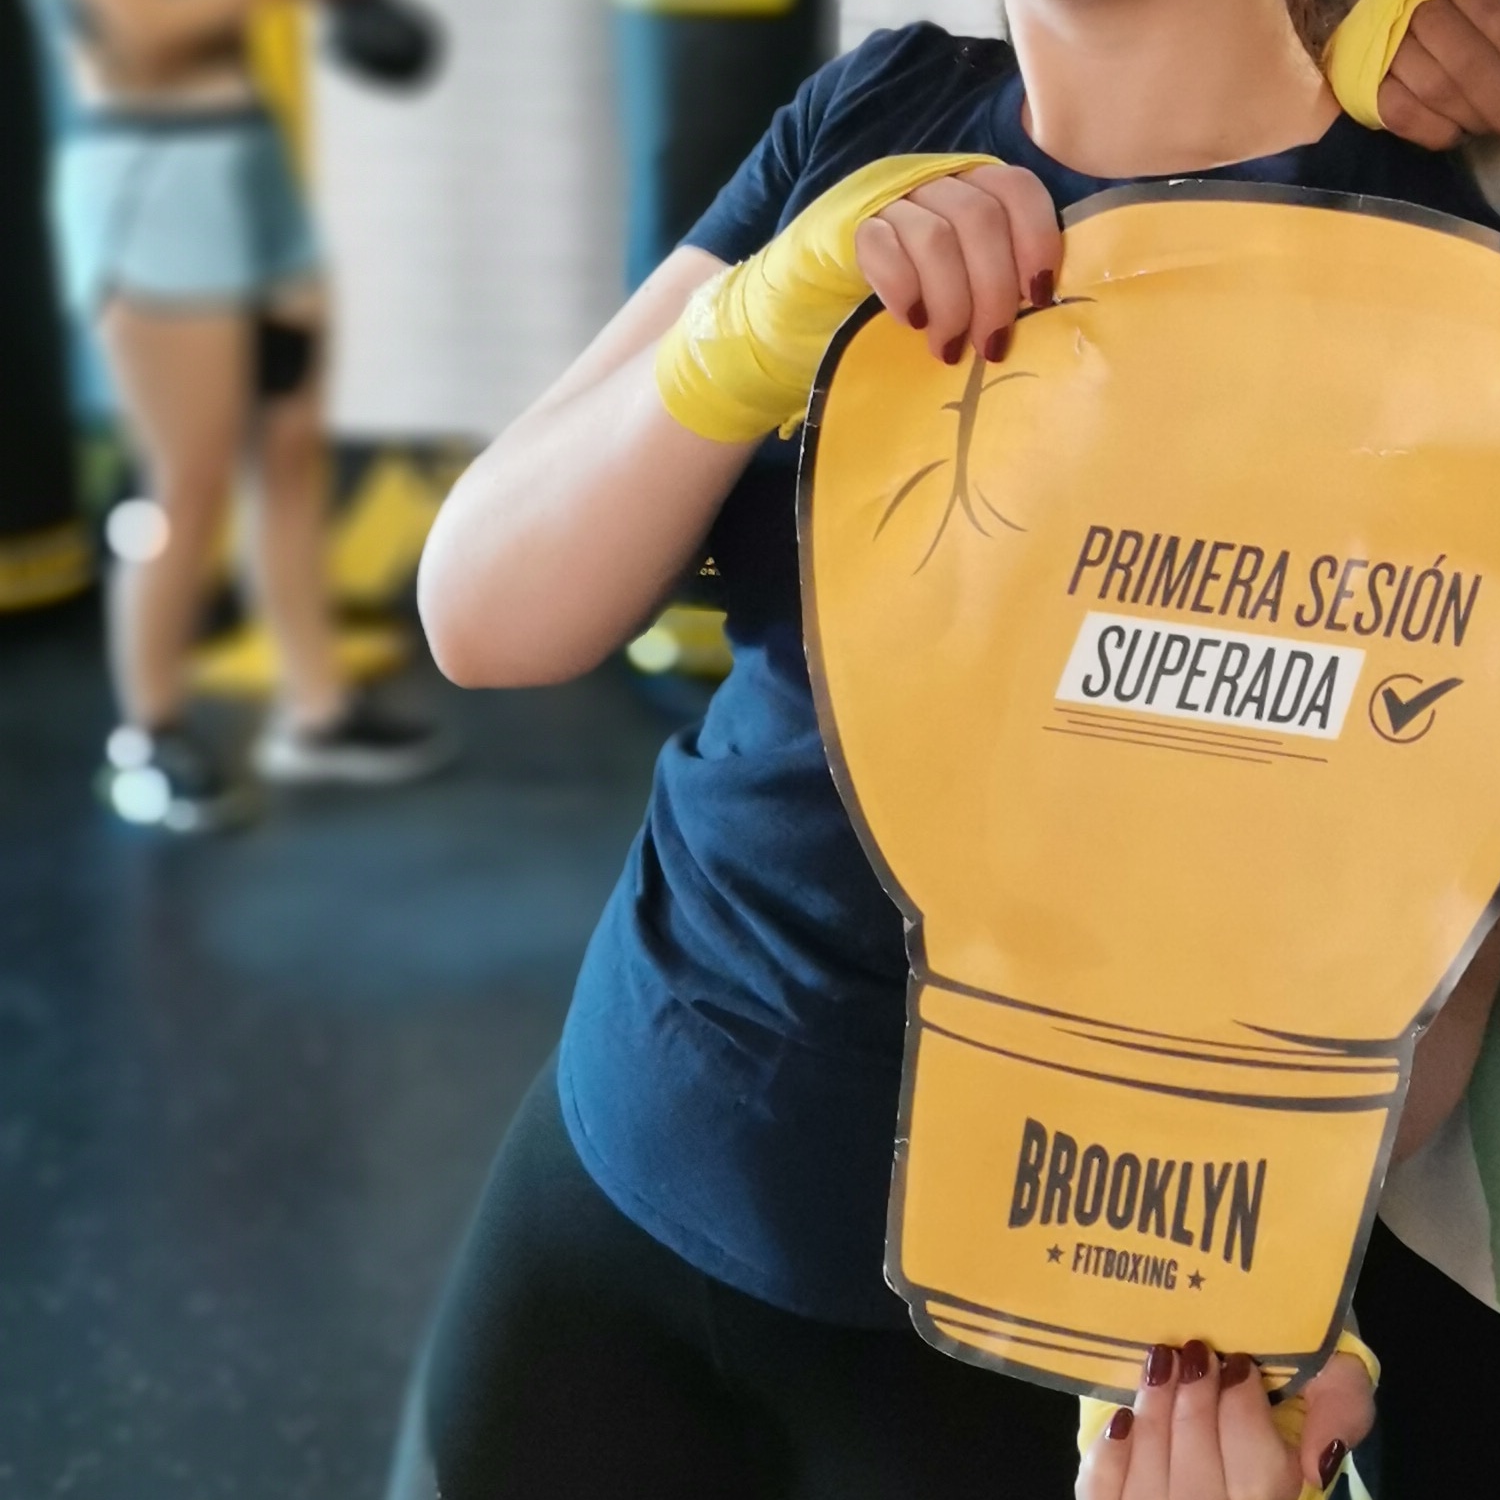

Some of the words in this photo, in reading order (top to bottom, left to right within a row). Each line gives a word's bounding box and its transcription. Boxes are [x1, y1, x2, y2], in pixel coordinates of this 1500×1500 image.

[1067, 525, 1291, 622] PRIMERA
[1294, 554, 1482, 647] SESIÓN
[1081, 625, 1340, 730] SUPERADA
[1008, 1116, 1267, 1273] BROOKLYN
[1071, 1243, 1179, 1290] FITBOXING
